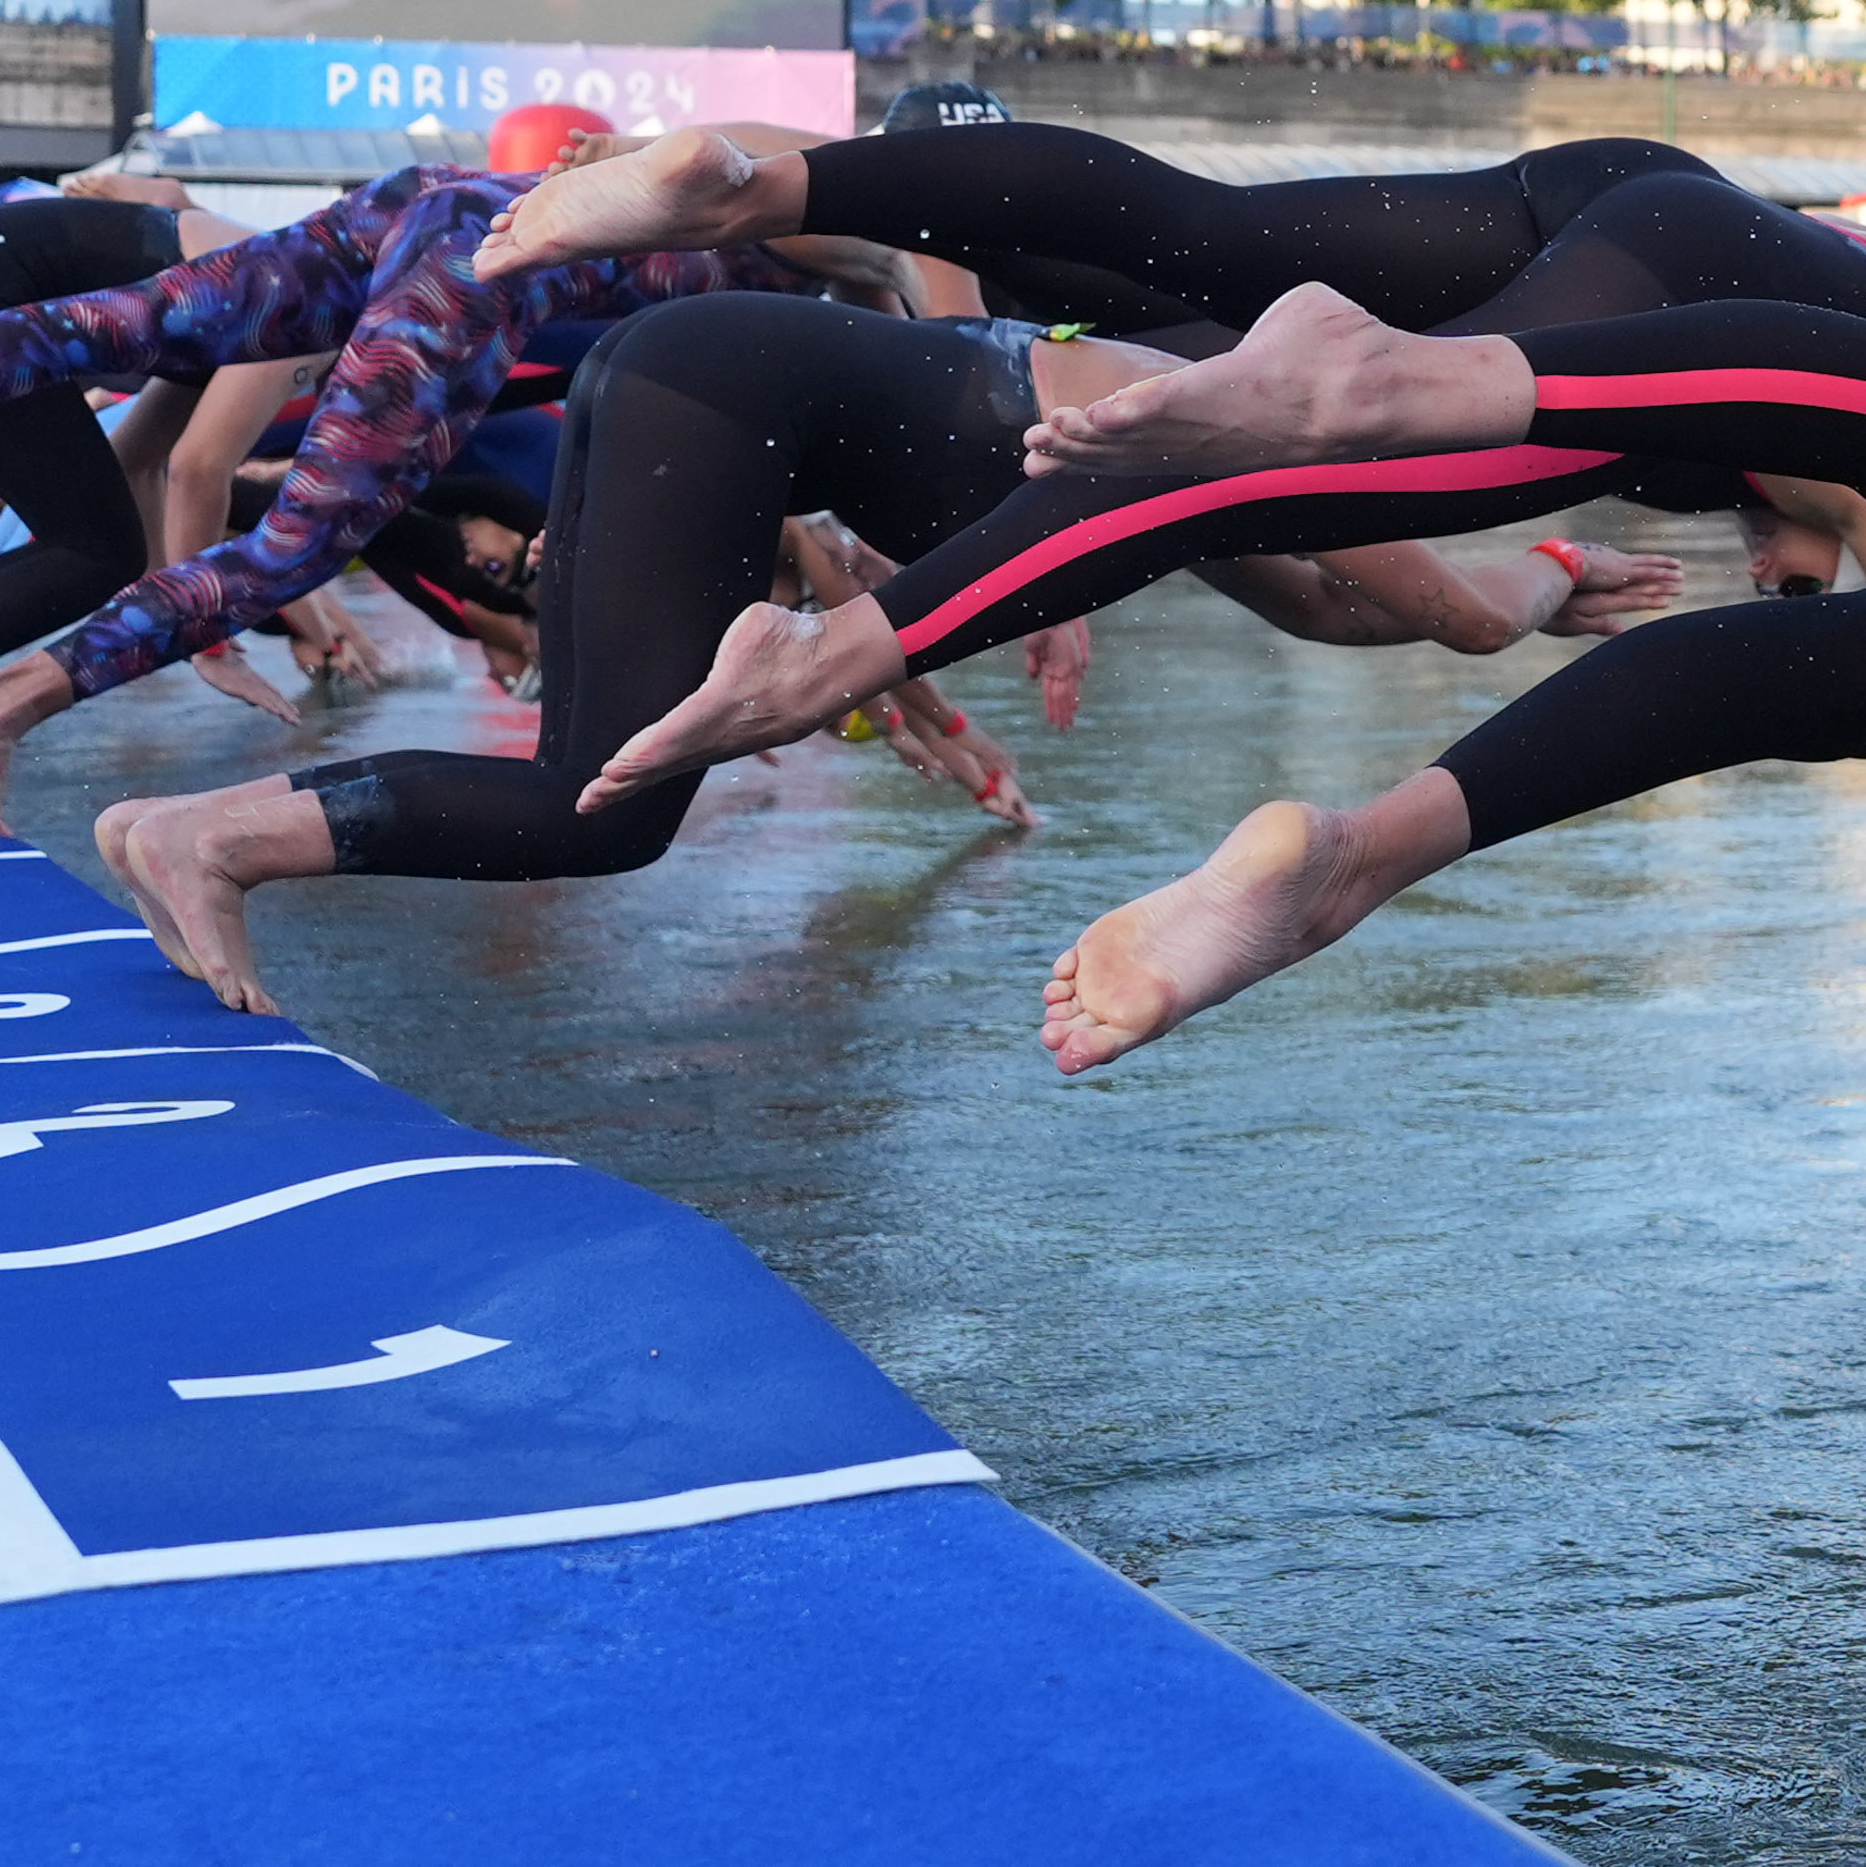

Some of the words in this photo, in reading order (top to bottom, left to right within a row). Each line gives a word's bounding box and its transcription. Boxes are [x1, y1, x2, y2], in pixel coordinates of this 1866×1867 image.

[533, 66, 697, 115] 2024
[937, 101, 1007, 127] USA
[168, 1324, 513, 1400] 1
